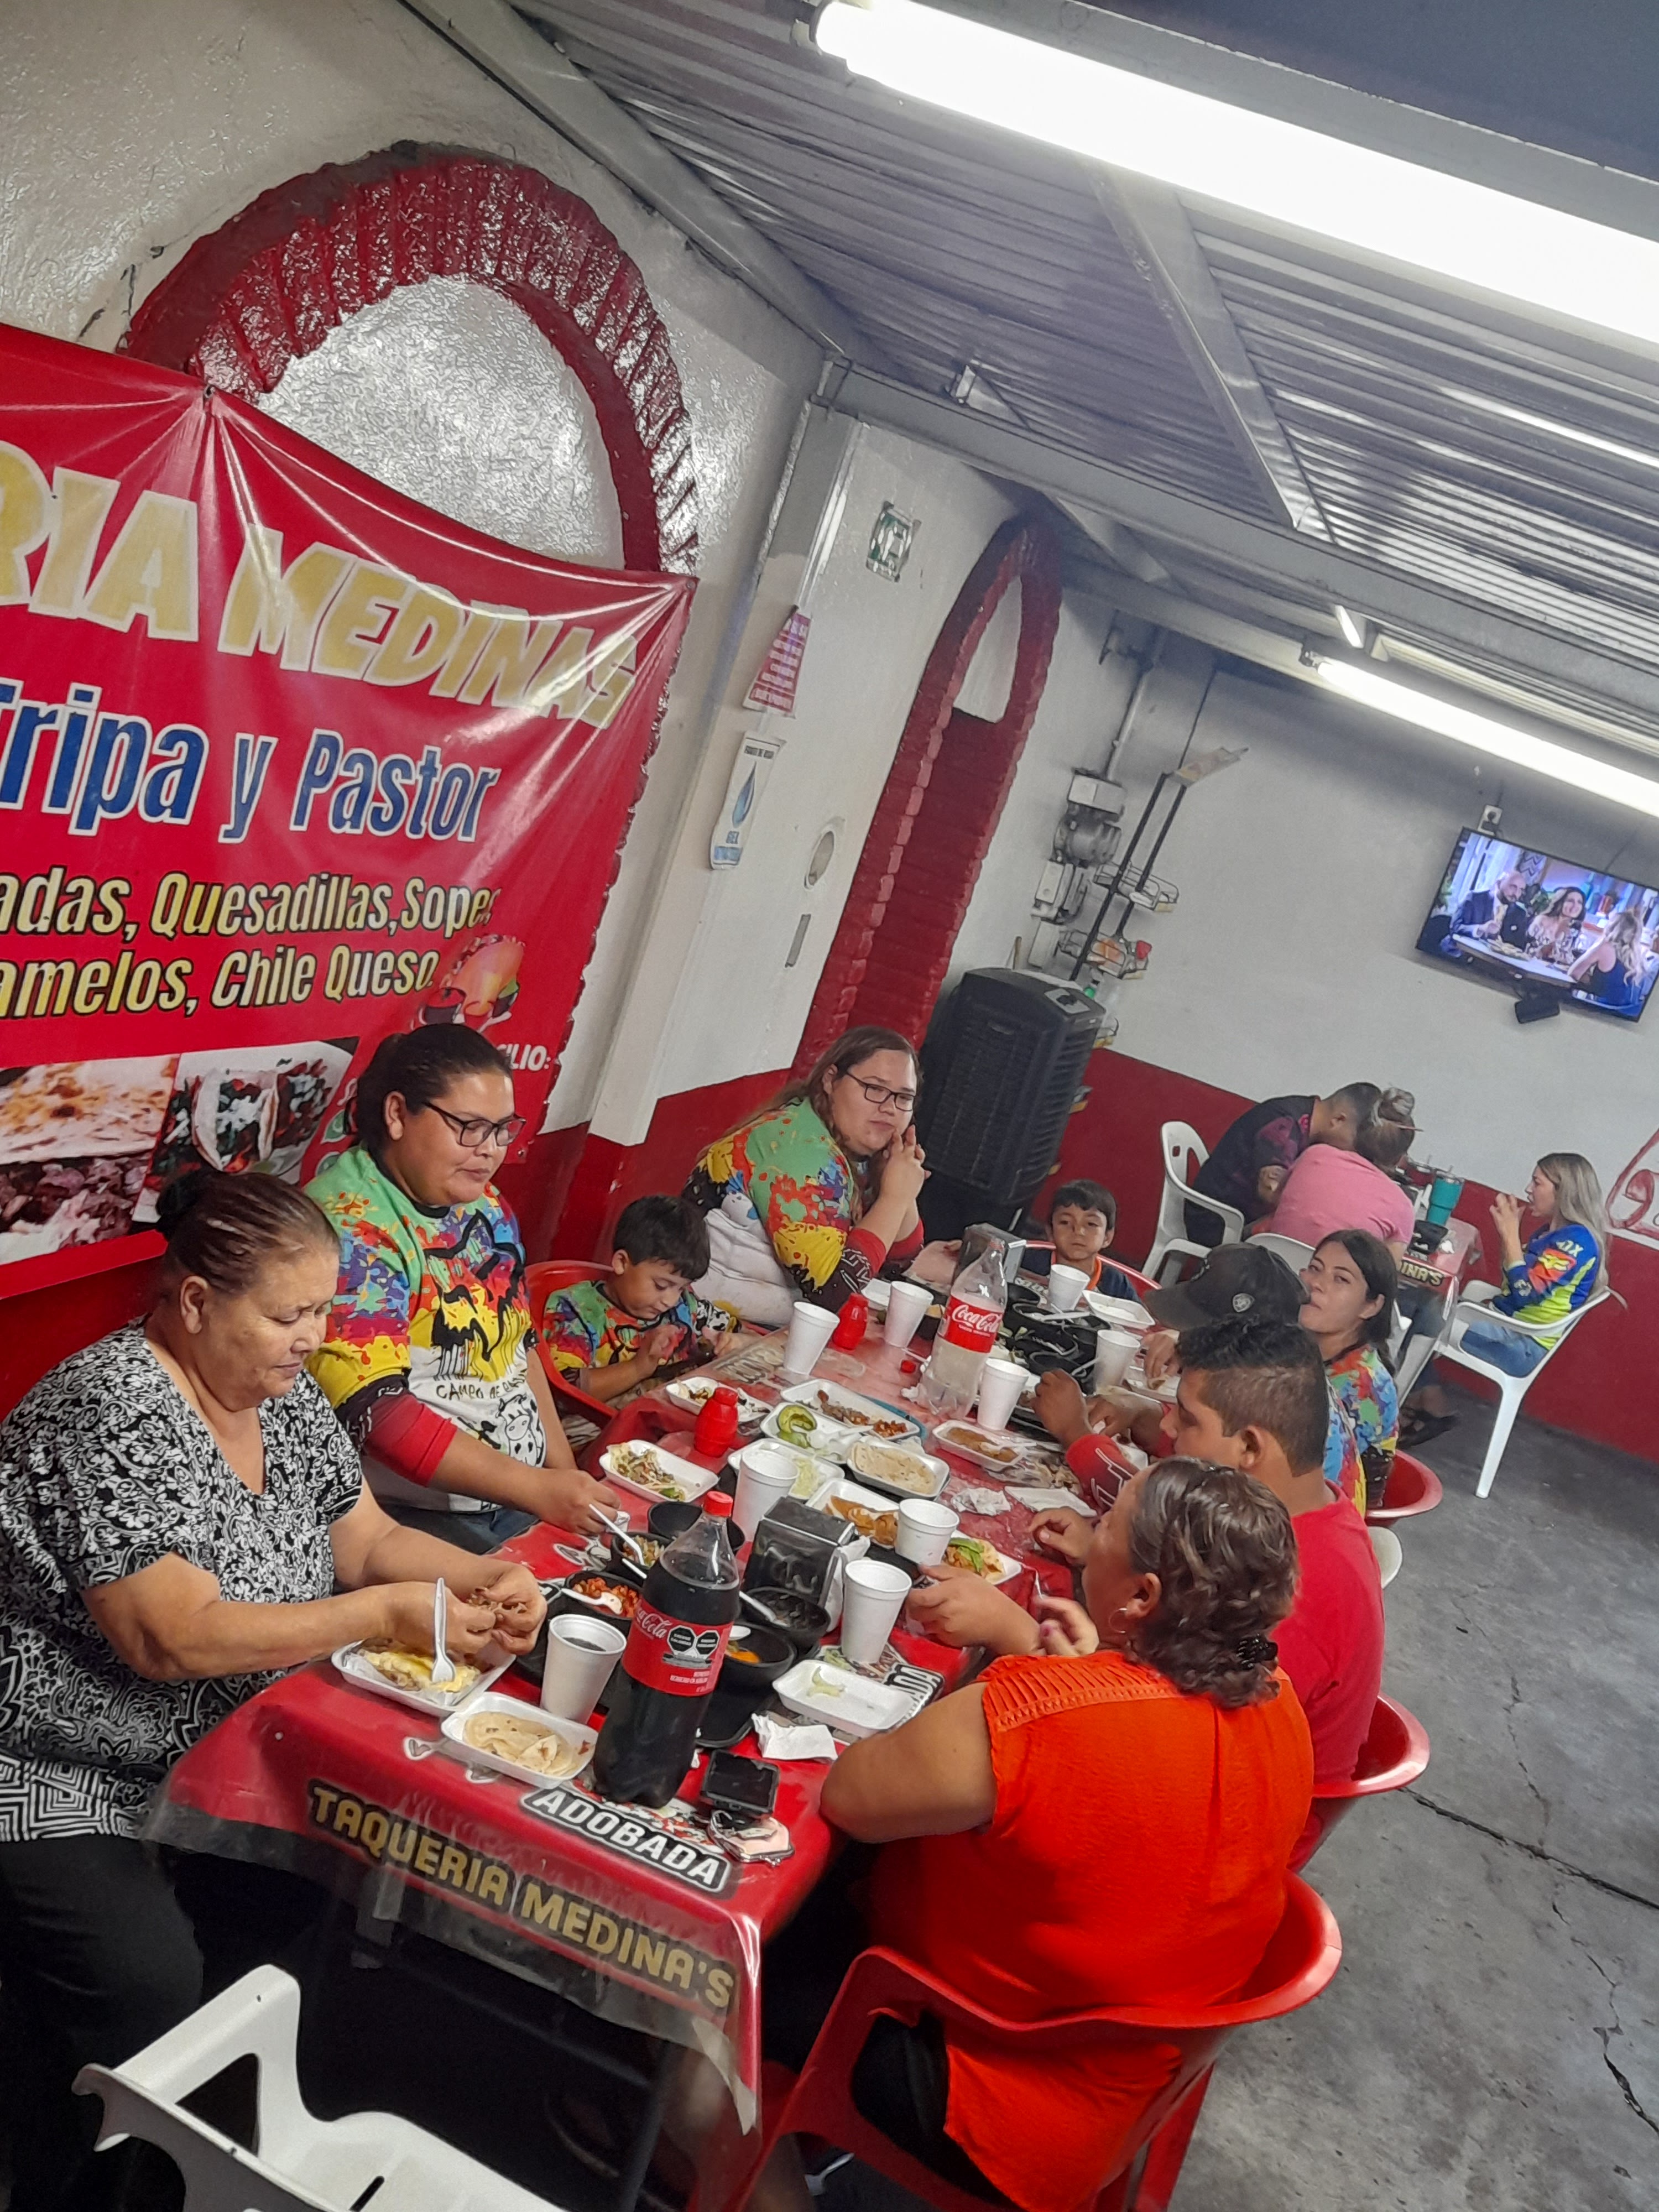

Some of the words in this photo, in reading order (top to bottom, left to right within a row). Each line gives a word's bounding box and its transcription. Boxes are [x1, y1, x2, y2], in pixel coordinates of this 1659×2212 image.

[217, 523, 638, 730] MEDINAS
[218, 732, 279, 844] y
[289, 727, 502, 842] Pastor
[150, 872, 398, 940] Quesadillas,
[210, 943, 317, 1008] Chile
[531, 1790, 720, 1886] ADOBADA
[314, 1786, 509, 1906] TAQUERIA
[520, 1882, 734, 2009] MEDINA'S
